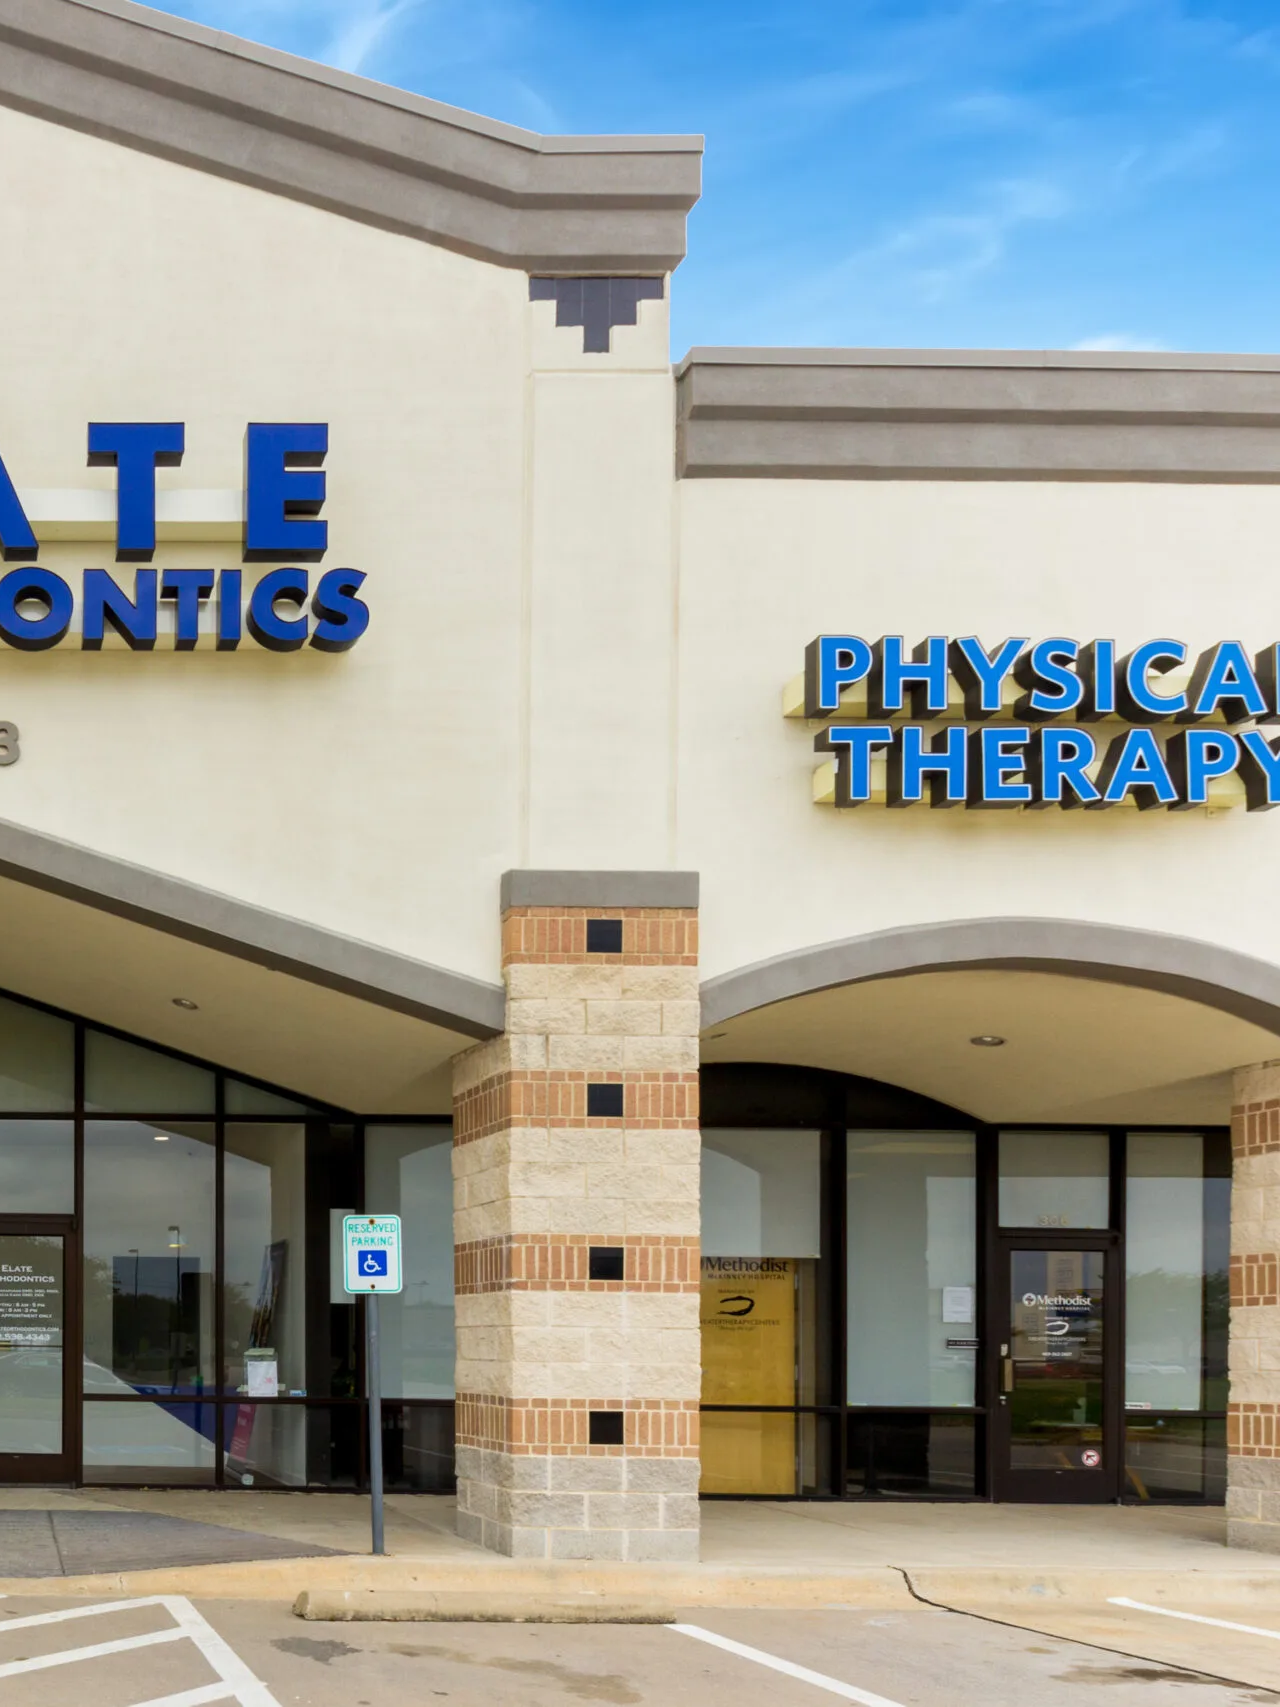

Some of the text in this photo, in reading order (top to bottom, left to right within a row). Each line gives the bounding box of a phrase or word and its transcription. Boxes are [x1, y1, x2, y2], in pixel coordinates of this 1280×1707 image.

[808, 635, 1280, 720] PHYSICA
[348, 1223, 397, 1233] RESERVED
[351, 1236, 393, 1246] PARKING
[1, 1264, 33, 1273] ELATE
[705, 1257, 789, 1273] Methodist
[1037, 1294, 1092, 1306] Methodist
